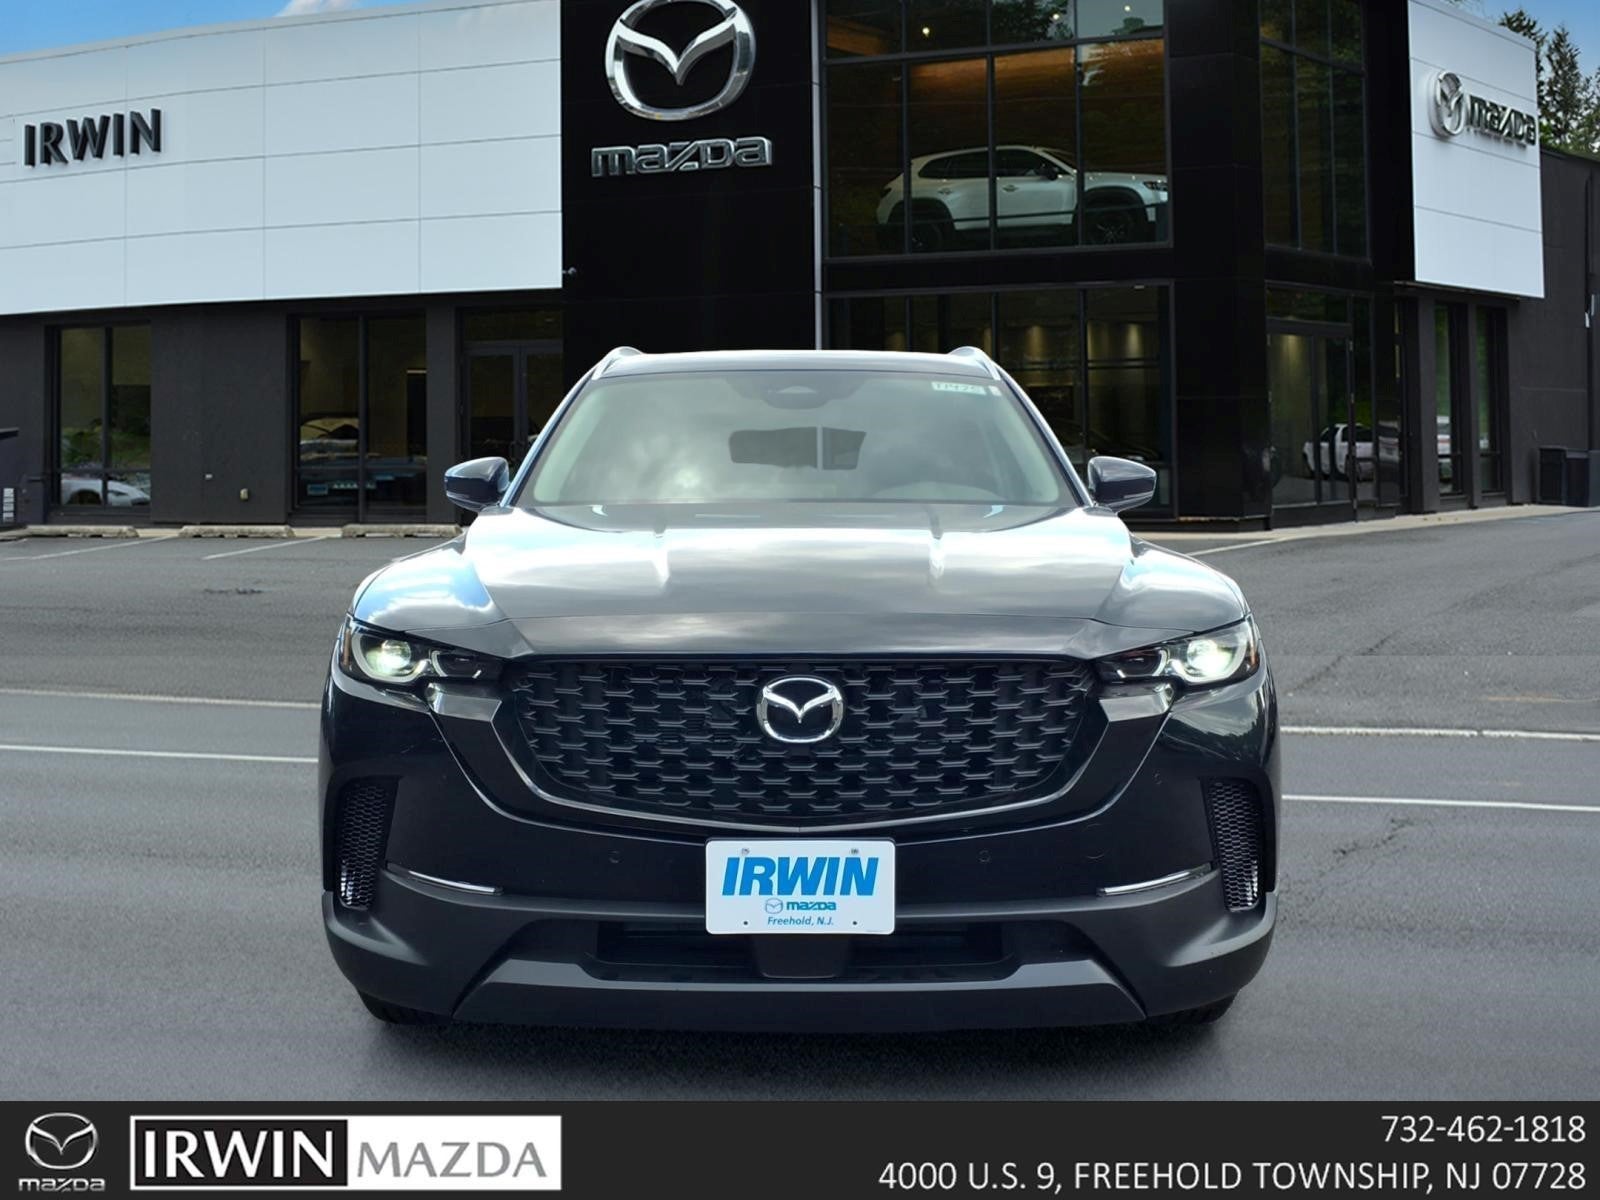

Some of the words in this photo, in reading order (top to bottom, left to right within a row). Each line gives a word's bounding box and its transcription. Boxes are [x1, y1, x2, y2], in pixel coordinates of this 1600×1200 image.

[24, 108, 162, 168] IRWIN
[722, 857, 879, 896] IRWIN
[767, 916, 814, 926] Freehold,
[817, 917, 834, 925] N.J.
